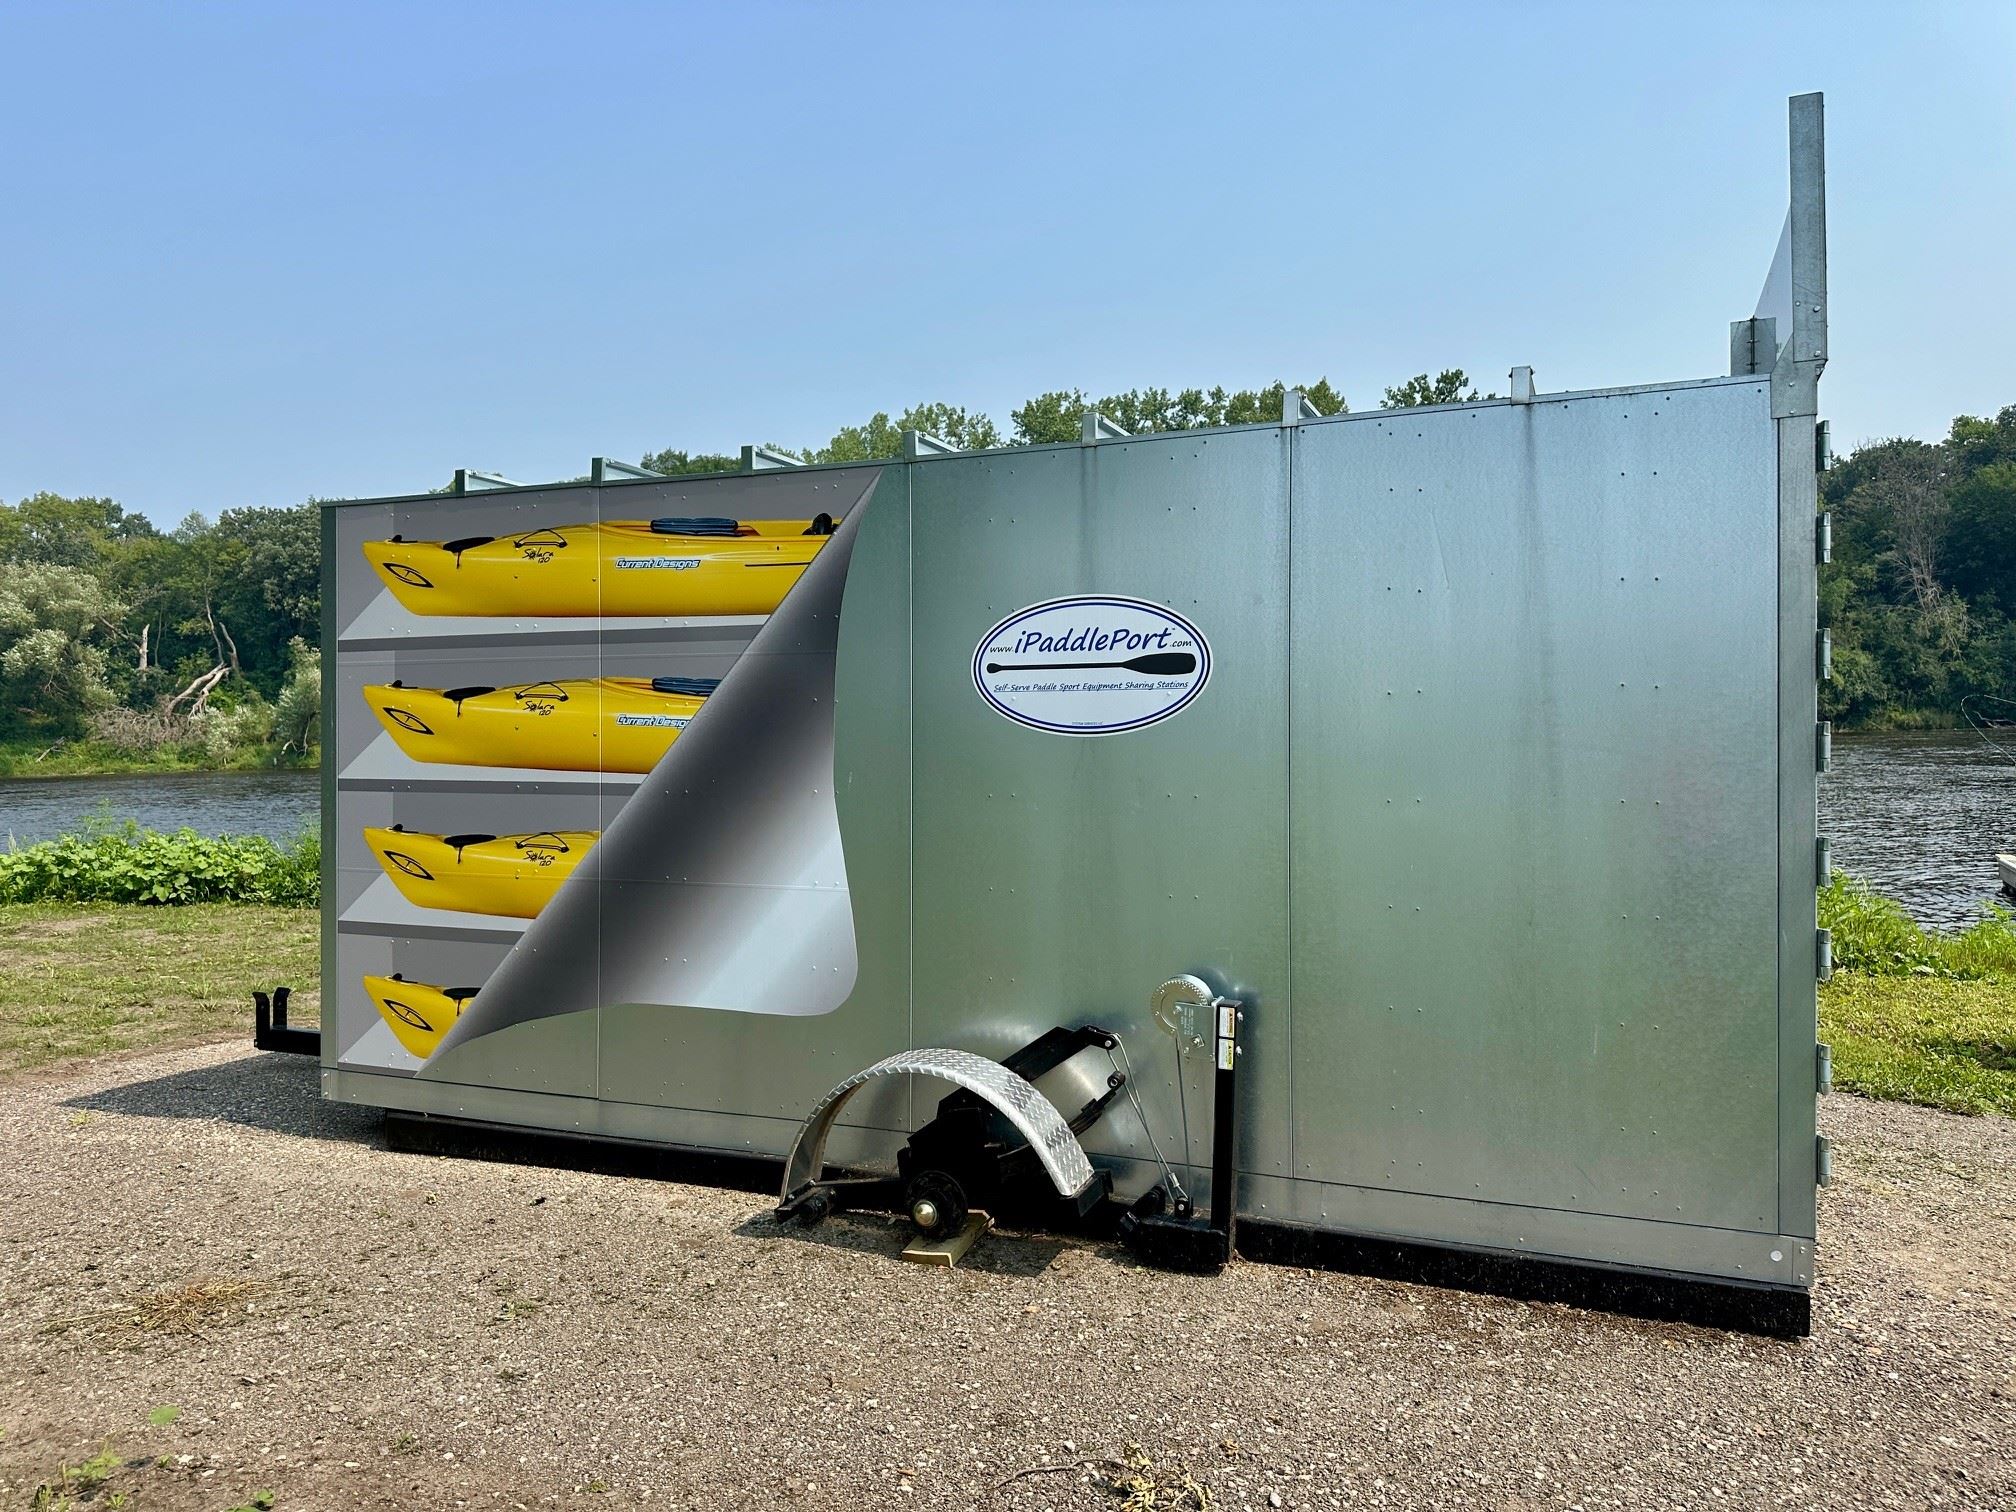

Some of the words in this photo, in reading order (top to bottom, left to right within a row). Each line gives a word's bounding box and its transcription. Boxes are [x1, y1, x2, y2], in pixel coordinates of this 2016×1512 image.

[616, 557, 655, 569] Current
[655, 557, 701, 570] Designs
[994, 683, 1031, 692] Self-Serve
[1032, 682, 1058, 691] Paddle
[1059, 682, 1081, 692] Sport
[1082, 681, 1123, 692] Equipment
[1124, 680, 1155, 691] Sharing
[1156, 679, 1189, 689] Stations
[617, 714, 656, 726] Current
